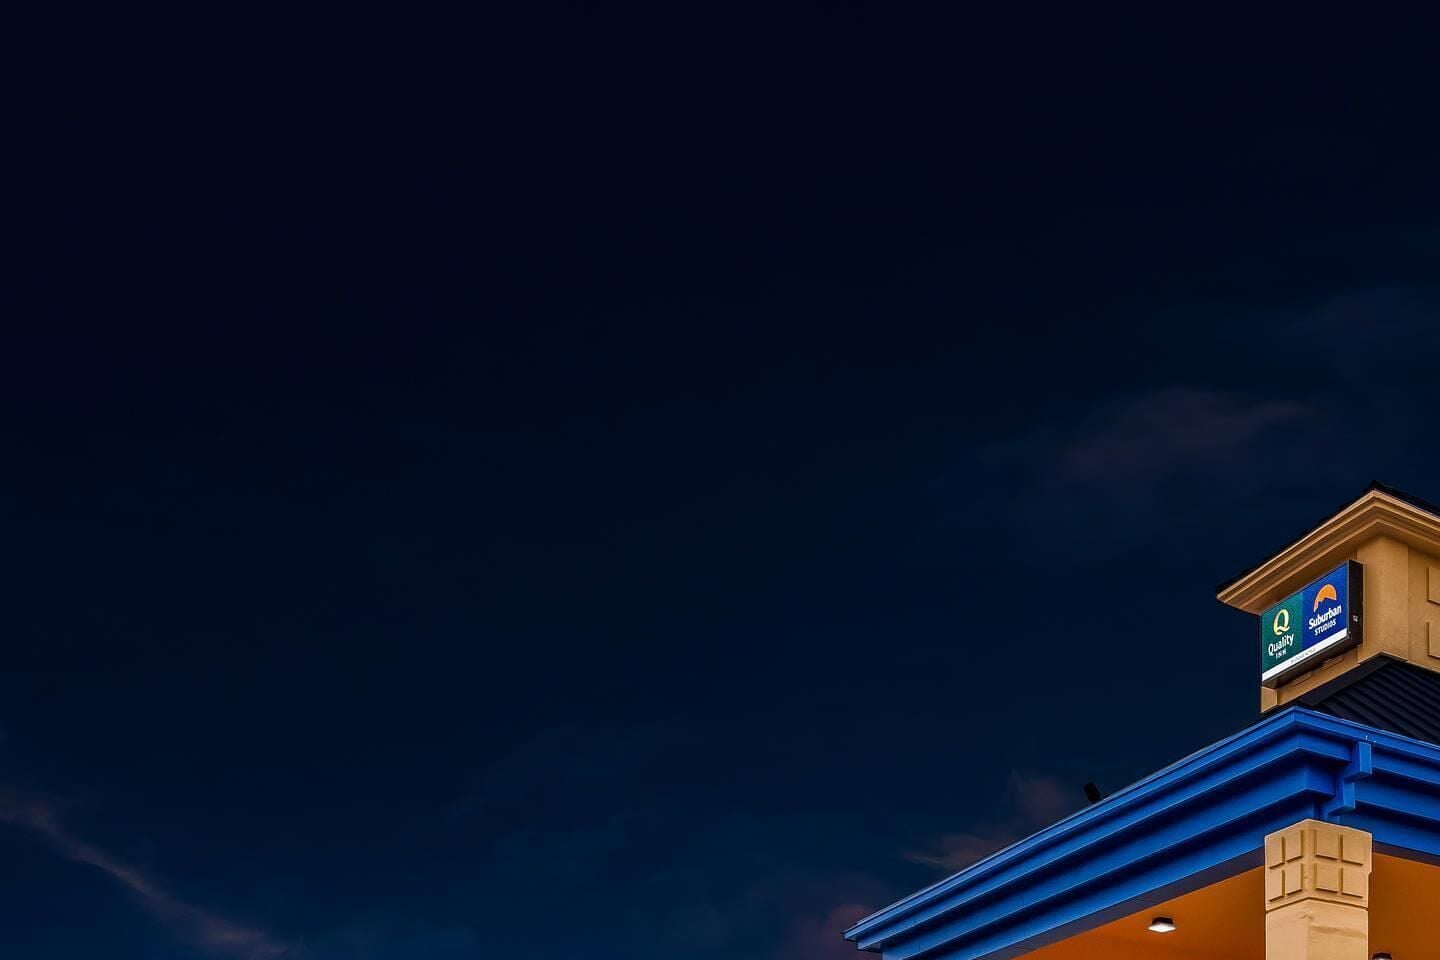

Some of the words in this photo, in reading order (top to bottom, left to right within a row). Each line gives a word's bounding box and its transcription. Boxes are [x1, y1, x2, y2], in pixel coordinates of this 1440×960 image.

[1273, 609, 1290, 636] Q
[1309, 605, 1342, 630] Suburban
[1314, 618, 1337, 636] STUDIOS
[1268, 634, 1294, 656] Quality
[1275, 648, 1287, 659] INN
